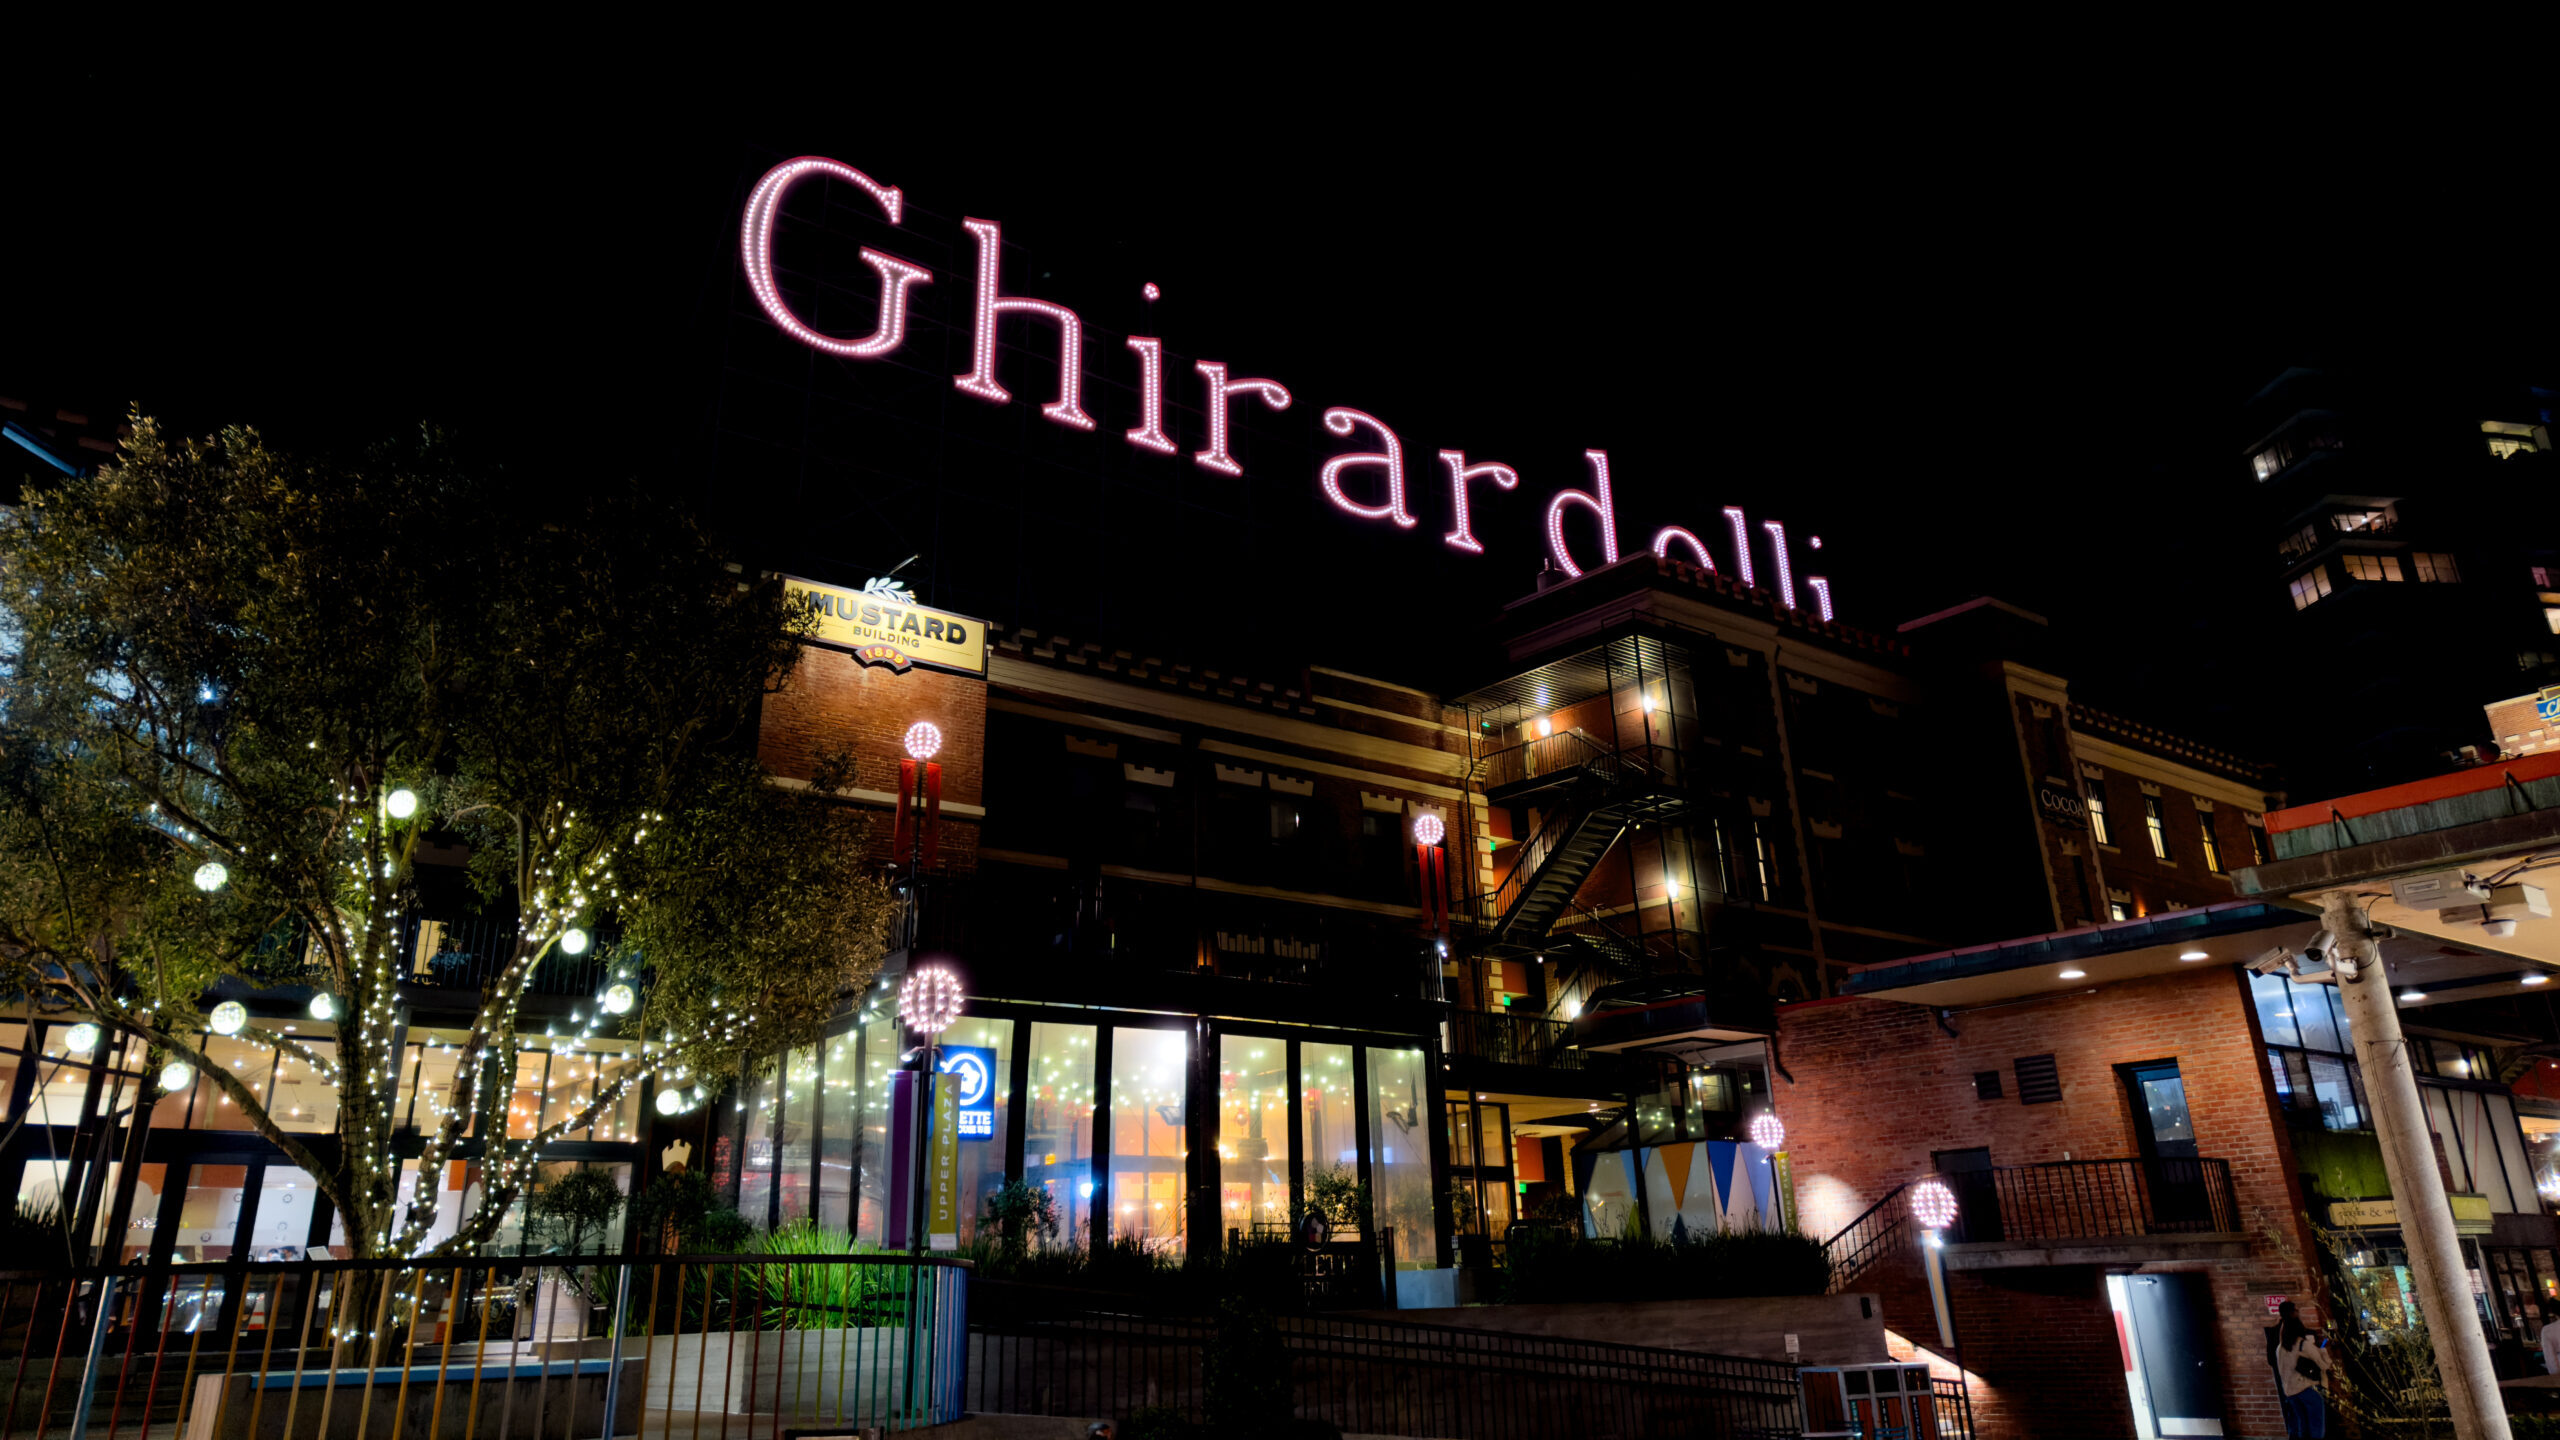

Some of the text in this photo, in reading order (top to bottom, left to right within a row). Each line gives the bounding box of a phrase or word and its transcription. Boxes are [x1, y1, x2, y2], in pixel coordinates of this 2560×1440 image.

[807, 591, 967, 645] MUSTARD
[853, 626, 920, 648] BUILDING
[865, 647, 905, 665] 1899
[2041, 789, 2086, 817] COCOA
[939, 1085, 953, 1220] UPPER PLAZA
